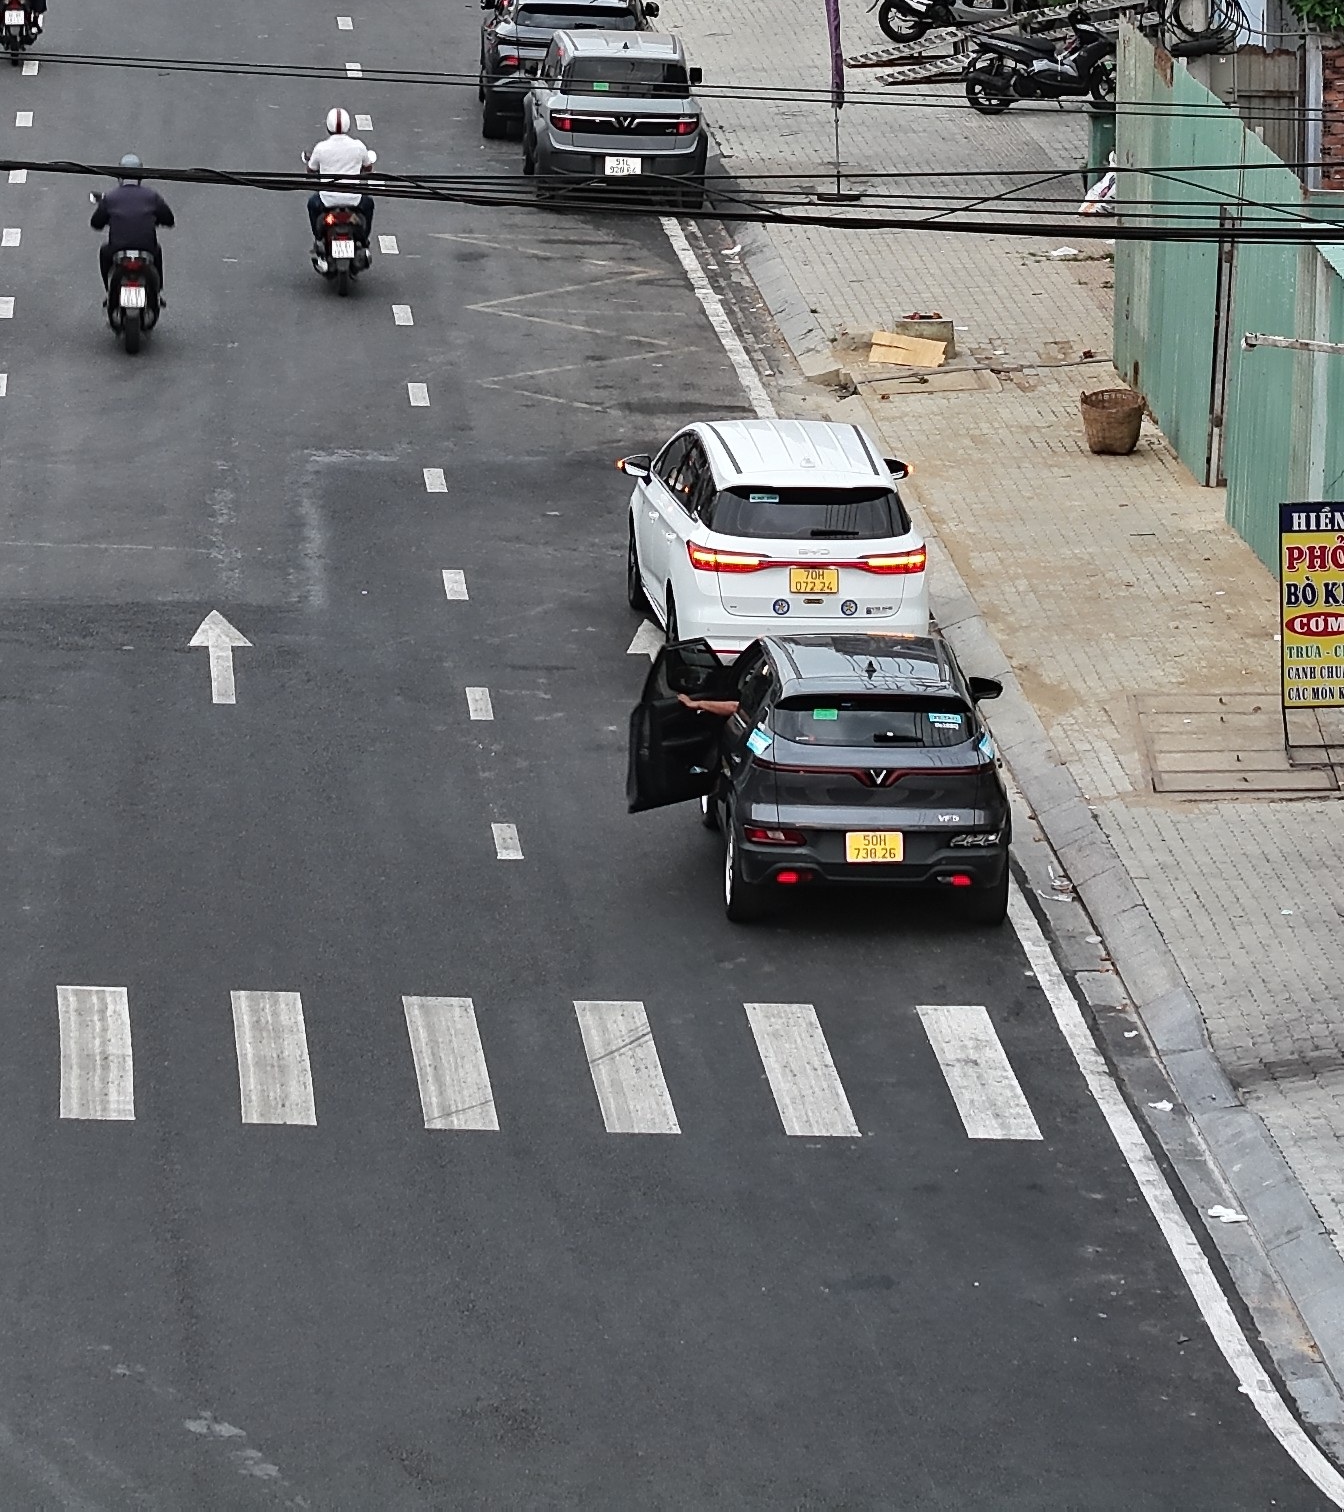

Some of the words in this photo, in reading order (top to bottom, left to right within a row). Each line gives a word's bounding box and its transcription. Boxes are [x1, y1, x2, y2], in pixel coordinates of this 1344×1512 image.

[804, 570, 825, 580] 70H
[795, 582, 833, 592] 072.24
[1285, 576, 1318, 607] BÒ
[1287, 666, 1317, 679] CANH
[863, 835, 887, 846] 50H
